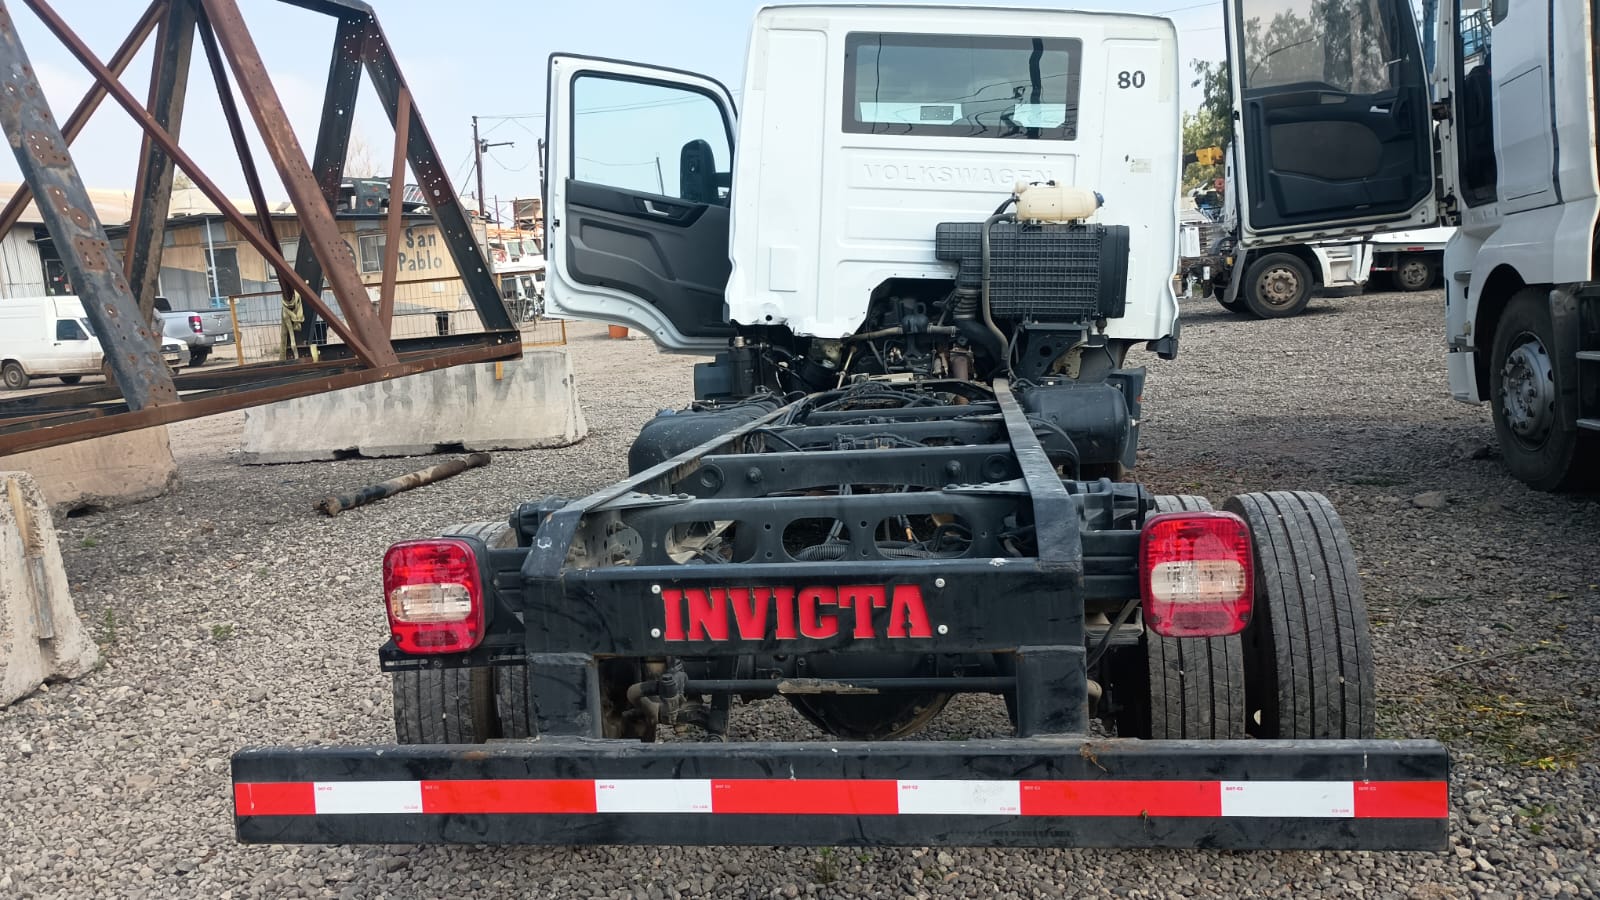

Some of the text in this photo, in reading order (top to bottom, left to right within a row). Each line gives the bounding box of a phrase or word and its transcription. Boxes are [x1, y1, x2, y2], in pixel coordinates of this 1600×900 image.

[1117, 70, 1146, 89] 80
[405, 228, 437, 249] San
[398, 249, 443, 272] Pablo
[661, 584, 933, 642] INVICTA
